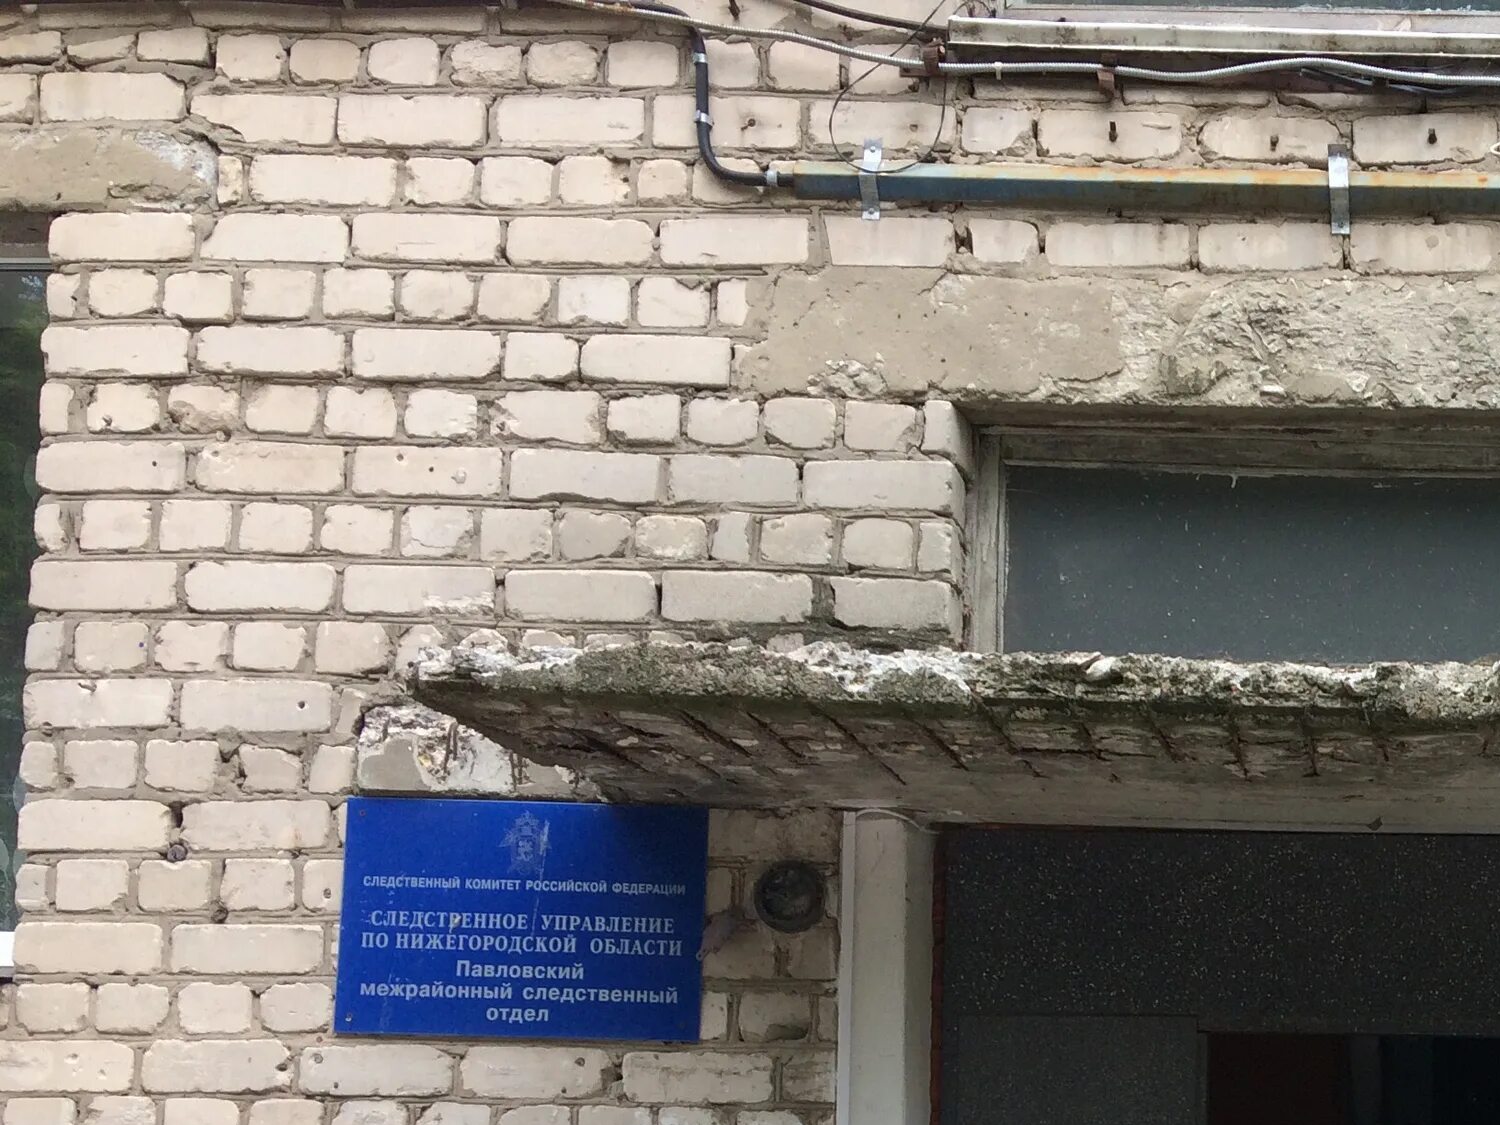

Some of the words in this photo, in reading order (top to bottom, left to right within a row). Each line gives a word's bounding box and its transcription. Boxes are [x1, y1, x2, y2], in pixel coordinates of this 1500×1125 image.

[363, 875, 460, 889] СЛЕДСТВЕННЫЙ
[465, 878, 521, 891] КОМИТЕТ
[525, 878, 607, 893] РОССИЙСКОЙ
[612, 883, 686, 895] ФЕДЕРАЦИИ
[541, 914, 675, 934] УПРАВЛЕНИЕ
[361, 931, 389, 948] ПО
[395, 932, 577, 954] НИЖЕГОРОДСКОЙ
[590, 938, 683, 956] ОБЛАСТИ
[456, 959, 585, 980] Павловский
[360, 981, 512, 1001] межрайонный
[522, 986, 678, 1005] следственный
[486, 1006, 549, 1023] отдел
